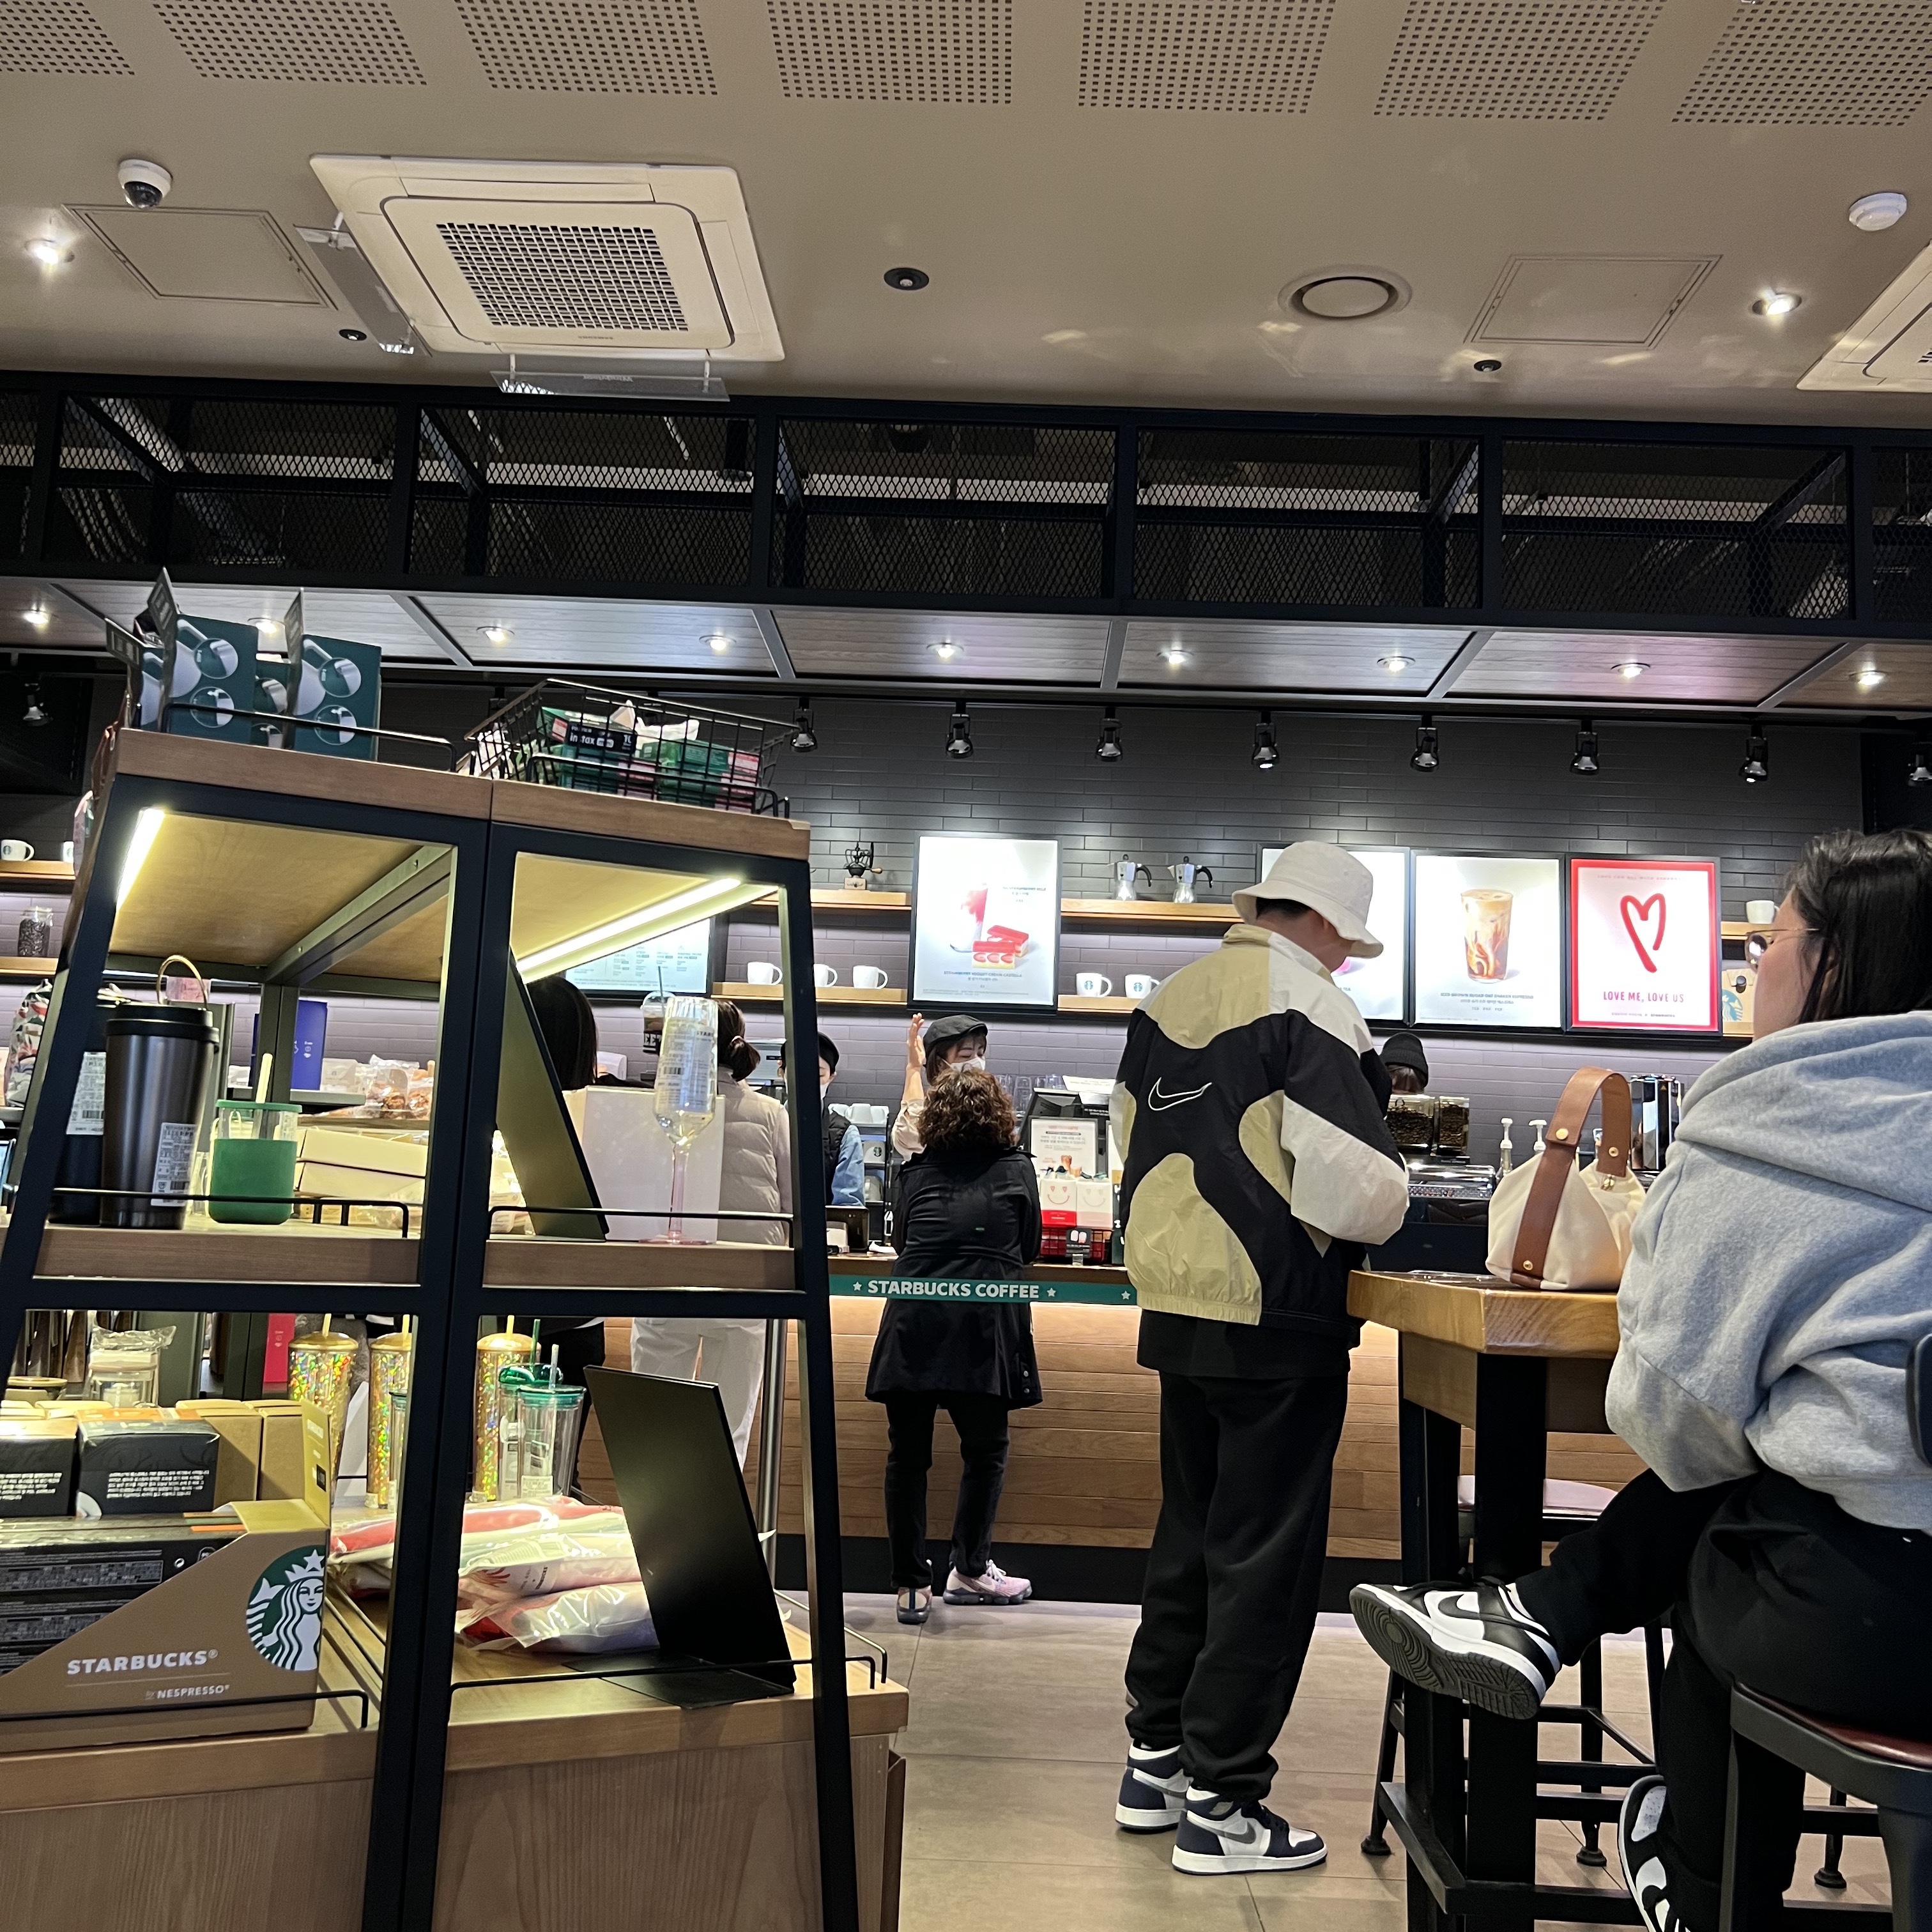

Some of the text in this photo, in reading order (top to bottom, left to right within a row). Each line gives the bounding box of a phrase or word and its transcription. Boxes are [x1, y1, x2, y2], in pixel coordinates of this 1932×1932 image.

[570, 732, 595, 745] intax
[1603, 991, 1684, 1003] LOVE ME, LOVE US
[868, 1280, 1039, 1299] STARBUCKS COFFEE
